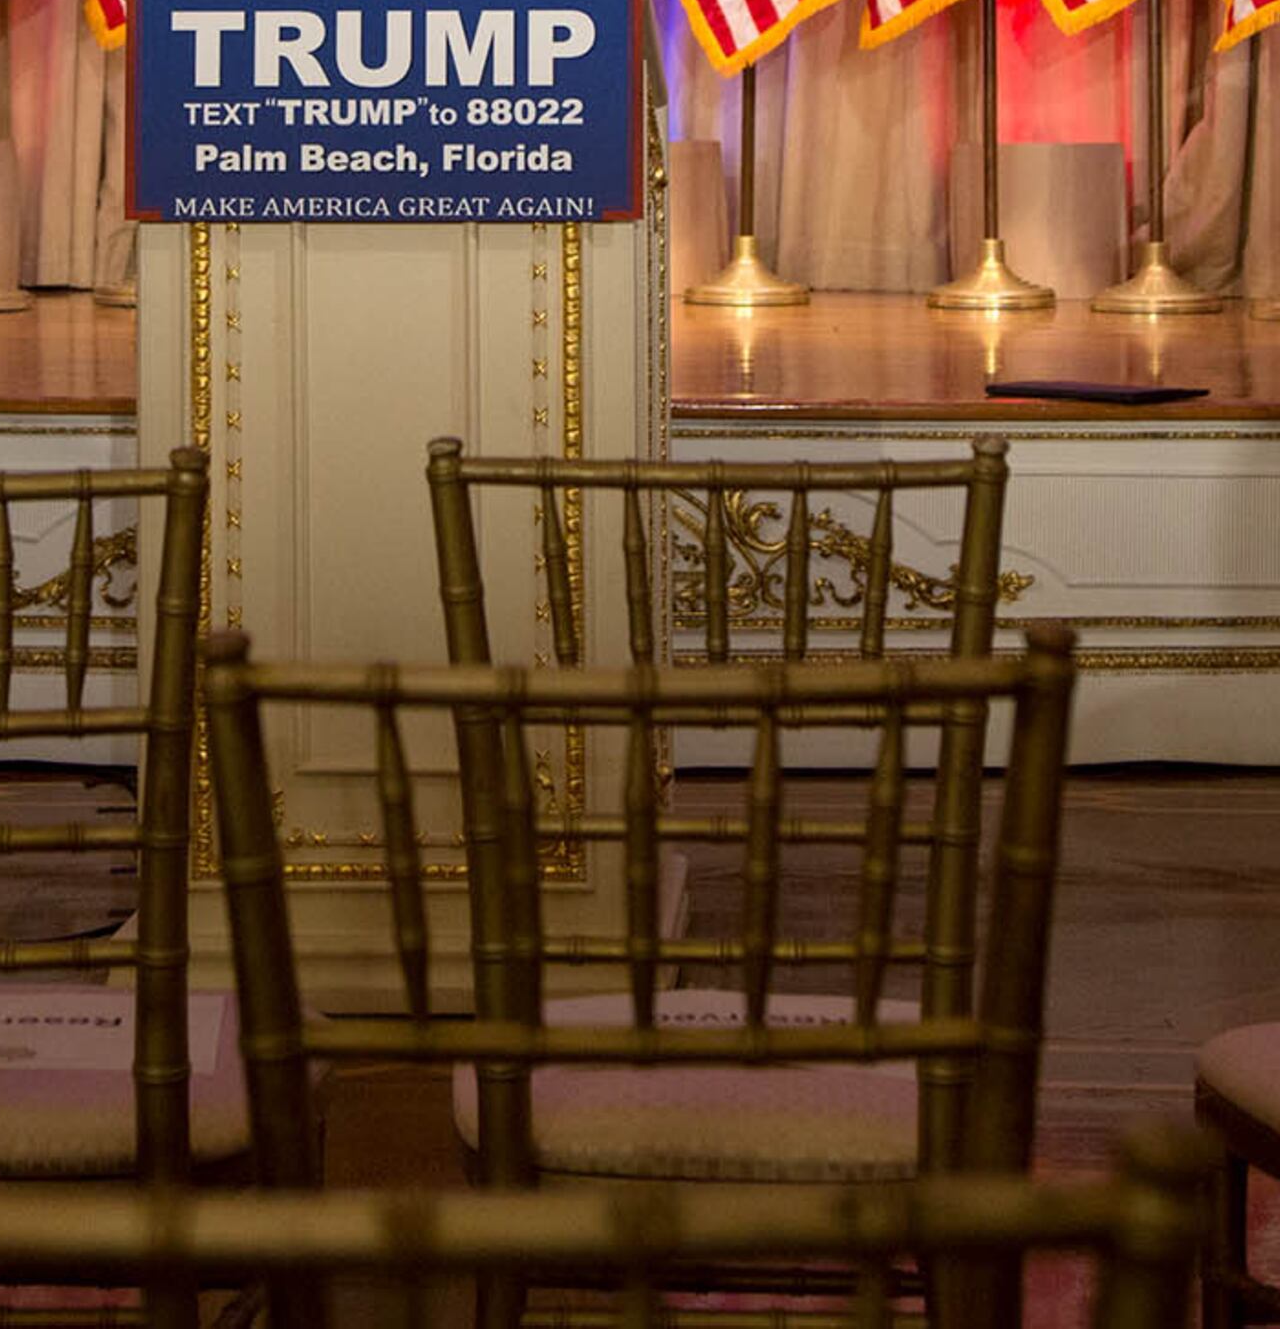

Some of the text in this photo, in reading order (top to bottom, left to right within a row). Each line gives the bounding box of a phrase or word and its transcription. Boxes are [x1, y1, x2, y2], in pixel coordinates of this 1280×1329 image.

[170, 9, 597, 88] TRUMP
[183, 102, 261, 126] TEXT
[429, 103, 458, 126] to
[466, 98, 584, 126] 88022
[194, 143, 573, 178] Palm Beach, Florida
[174, 196, 594, 217] MAKE AMERICA GREAT AGAIN!
